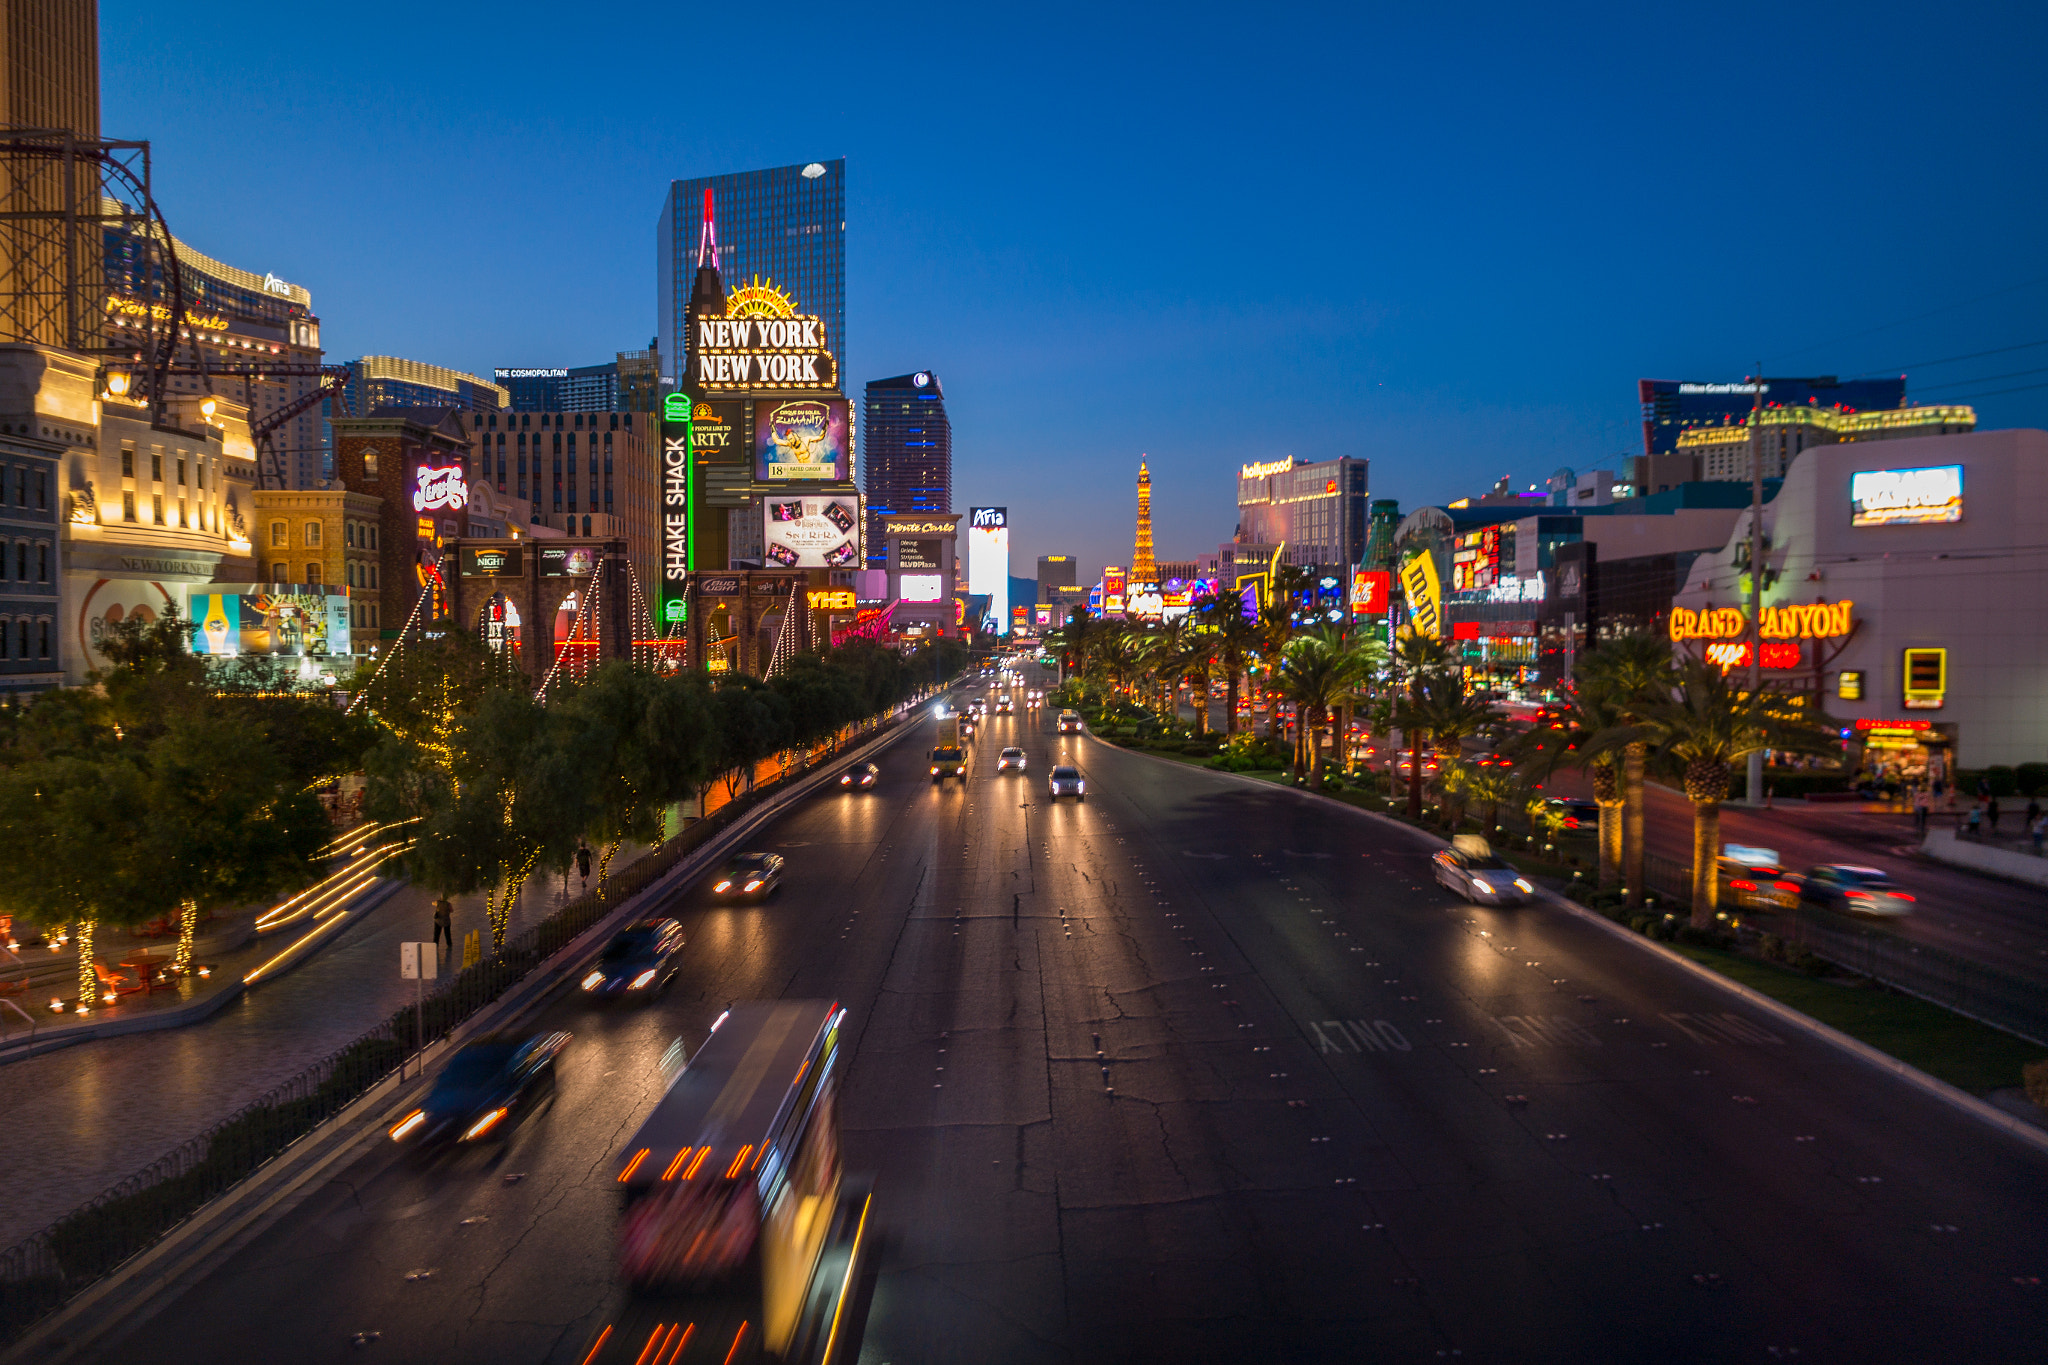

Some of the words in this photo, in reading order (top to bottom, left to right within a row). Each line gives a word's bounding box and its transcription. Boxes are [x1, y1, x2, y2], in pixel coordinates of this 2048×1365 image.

[264, 272, 290, 296] Aria
[178, 310, 230, 331] arlo
[698, 320, 752, 348] NEW
[755, 320, 819, 348] YORK
[494, 369, 509, 378] THE
[510, 369, 568, 378] COSMOPOLITAN
[698, 354, 752, 382] NEW
[755, 354, 820, 382] YORK
[1731, 383, 1769, 394] Vacatins
[665, 436, 686, 507] SHACK
[1242, 455, 1293, 481] hollywood
[973, 508, 1005, 526] Aria
[886, 522, 921, 533] Monte
[921, 522, 956, 534] Carlo
[666, 513, 686, 581] SHAKE
[120, 558, 153, 570] NEW
[157, 560, 188, 573] YORK
[477, 557, 506, 566] NIGHT
[1109, 578, 1123, 591] ph
[1669, 606, 1745, 642] GRAND
